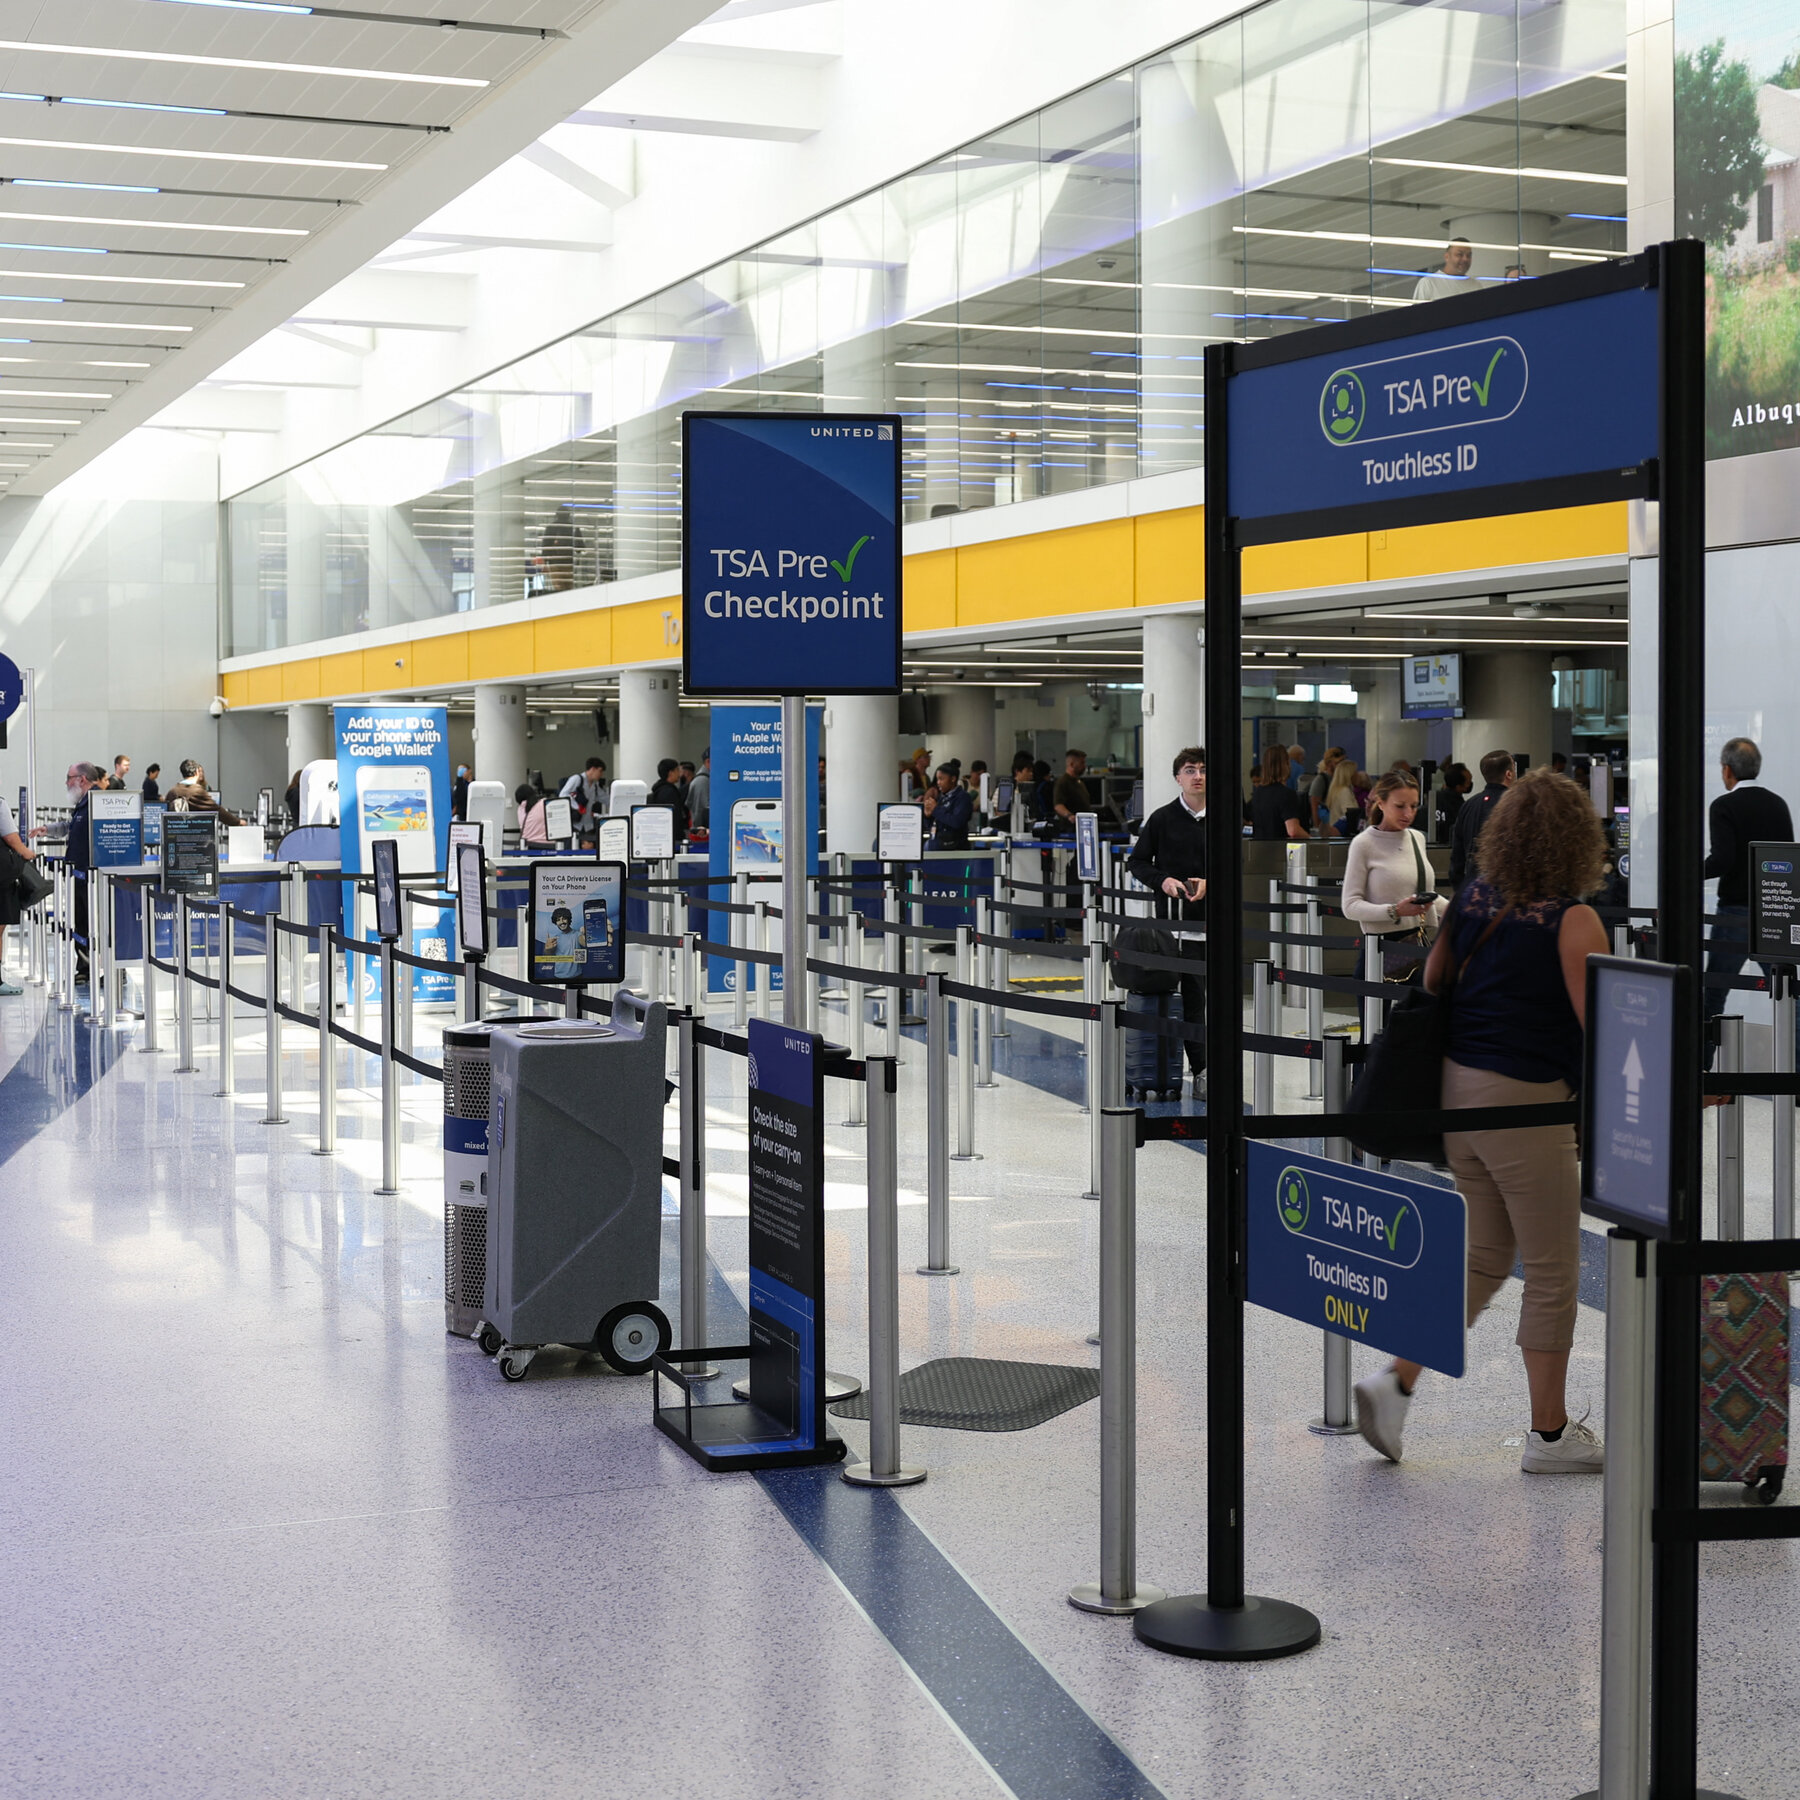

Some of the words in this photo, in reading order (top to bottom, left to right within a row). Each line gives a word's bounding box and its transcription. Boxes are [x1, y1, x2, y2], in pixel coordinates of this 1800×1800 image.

[1384, 378, 1427, 415] TSA
[1433, 374, 1471, 408] Pre
[810, 427, 874, 437] UNITED
[1362, 451, 1452, 485] Touchless
[1457, 444, 1478, 472] ID
[710, 549, 770, 578] TSA
[778, 549, 828, 578] Pre
[704, 590, 884, 623] Checkpoint
[348, 717, 373, 729] Add
[374, 718, 404, 731] your
[405, 717, 419, 729] ID
[421, 718, 434, 729] to
[750, 721, 771, 731] Your
[342, 732, 371, 744] your
[373, 730, 412, 744] phone
[414, 730, 441, 742] with
[732, 733, 741, 742] in
[743, 733, 769, 743] Apple
[349, 743, 392, 758] Google
[734, 745, 777, 755] Accepted
[1771, 880, 1788, 888] through
[1762, 910, 1772, 918] your
[421, 976, 436, 984] TSA
[437, 976, 449, 984] Pre
[784, 1037, 810, 1054] UNITED
[753, 1105, 773, 1130] Check
[774, 1113, 784, 1133] the
[785, 1118, 798, 1138] size
[464, 1141, 486, 1151] mixed
[753, 1131, 760, 1147] of
[760, 1136, 774, 1154] your
[774, 1142, 801, 1165] carry-on
[756, 1164, 771, 1179] carry-on
[776, 1174, 793, 1189] personal
[1322, 1196, 1353, 1232] TSA
[1357, 1205, 1384, 1241] Pre
[1306, 1253, 1370, 1296] Touchless
[1373, 1275, 1388, 1301] ID
[1324, 1294, 1370, 1333] ONLY
